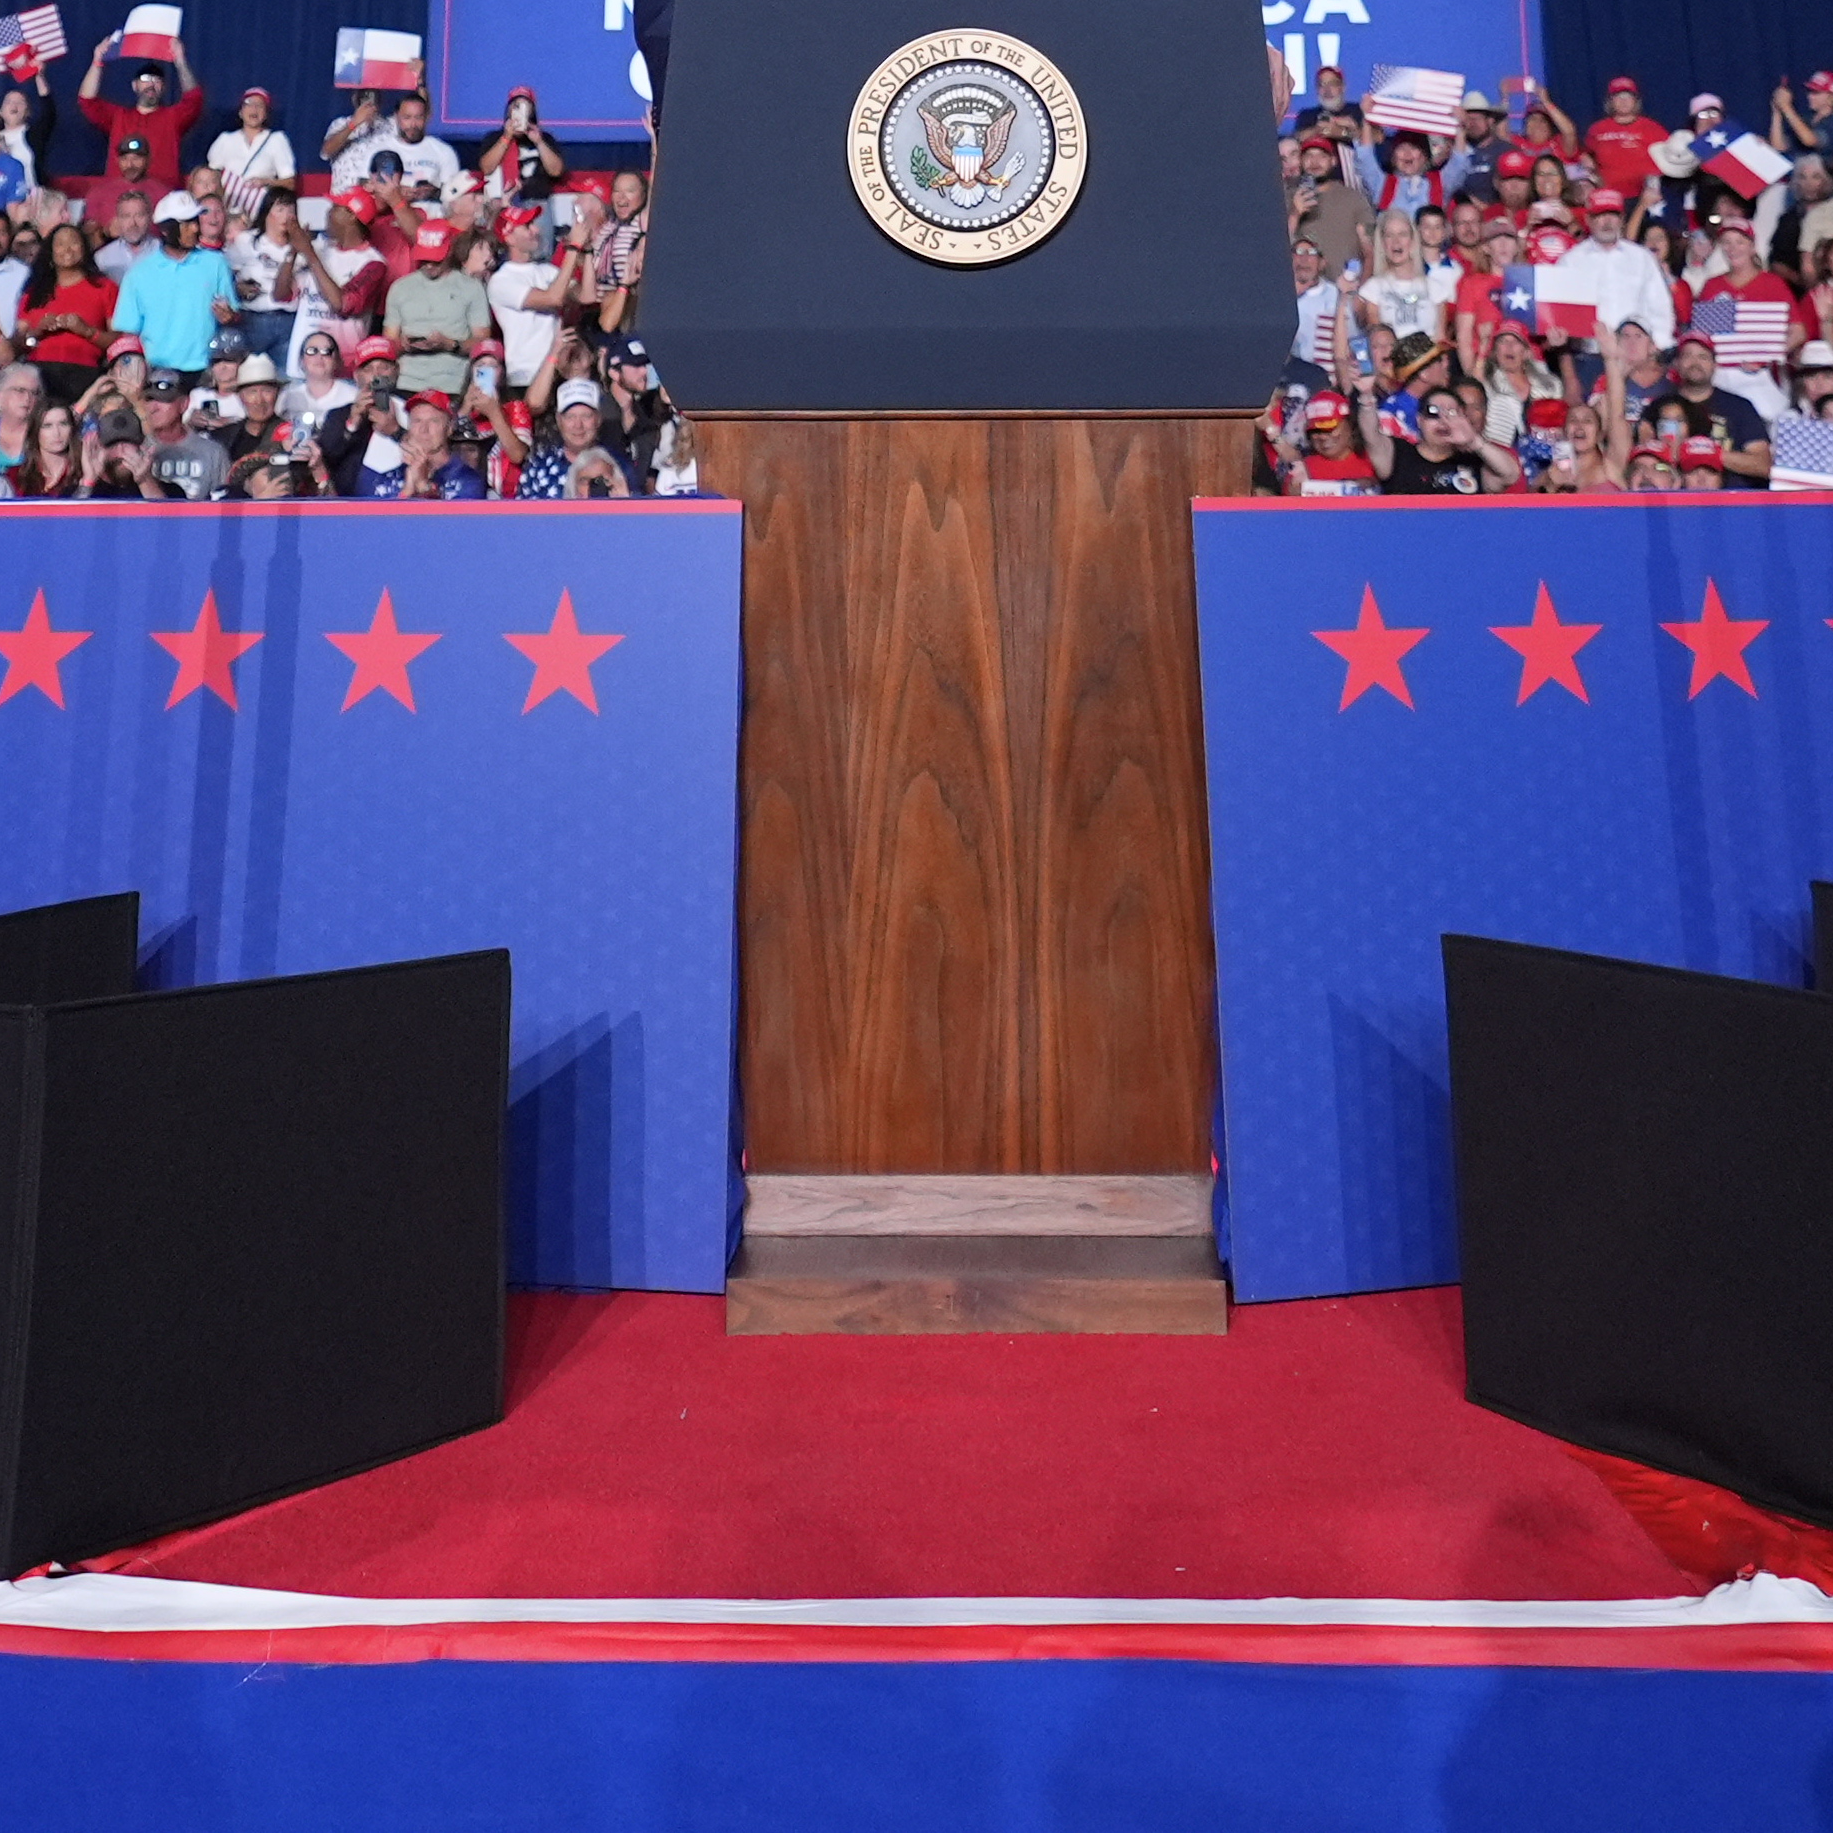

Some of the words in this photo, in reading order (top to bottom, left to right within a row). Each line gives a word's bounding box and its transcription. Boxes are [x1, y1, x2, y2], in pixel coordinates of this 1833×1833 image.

[970, 40, 993, 55] OF
[996, 44, 1026, 68] THE
[857, 38, 964, 136] PRESIDENT
[1030, 65, 1078, 160] UNITED
[859, 145, 876, 178] THE
[867, 182, 885, 202] OF
[884, 200, 944, 250] SEAL
[987, 181, 1068, 251] STATES
